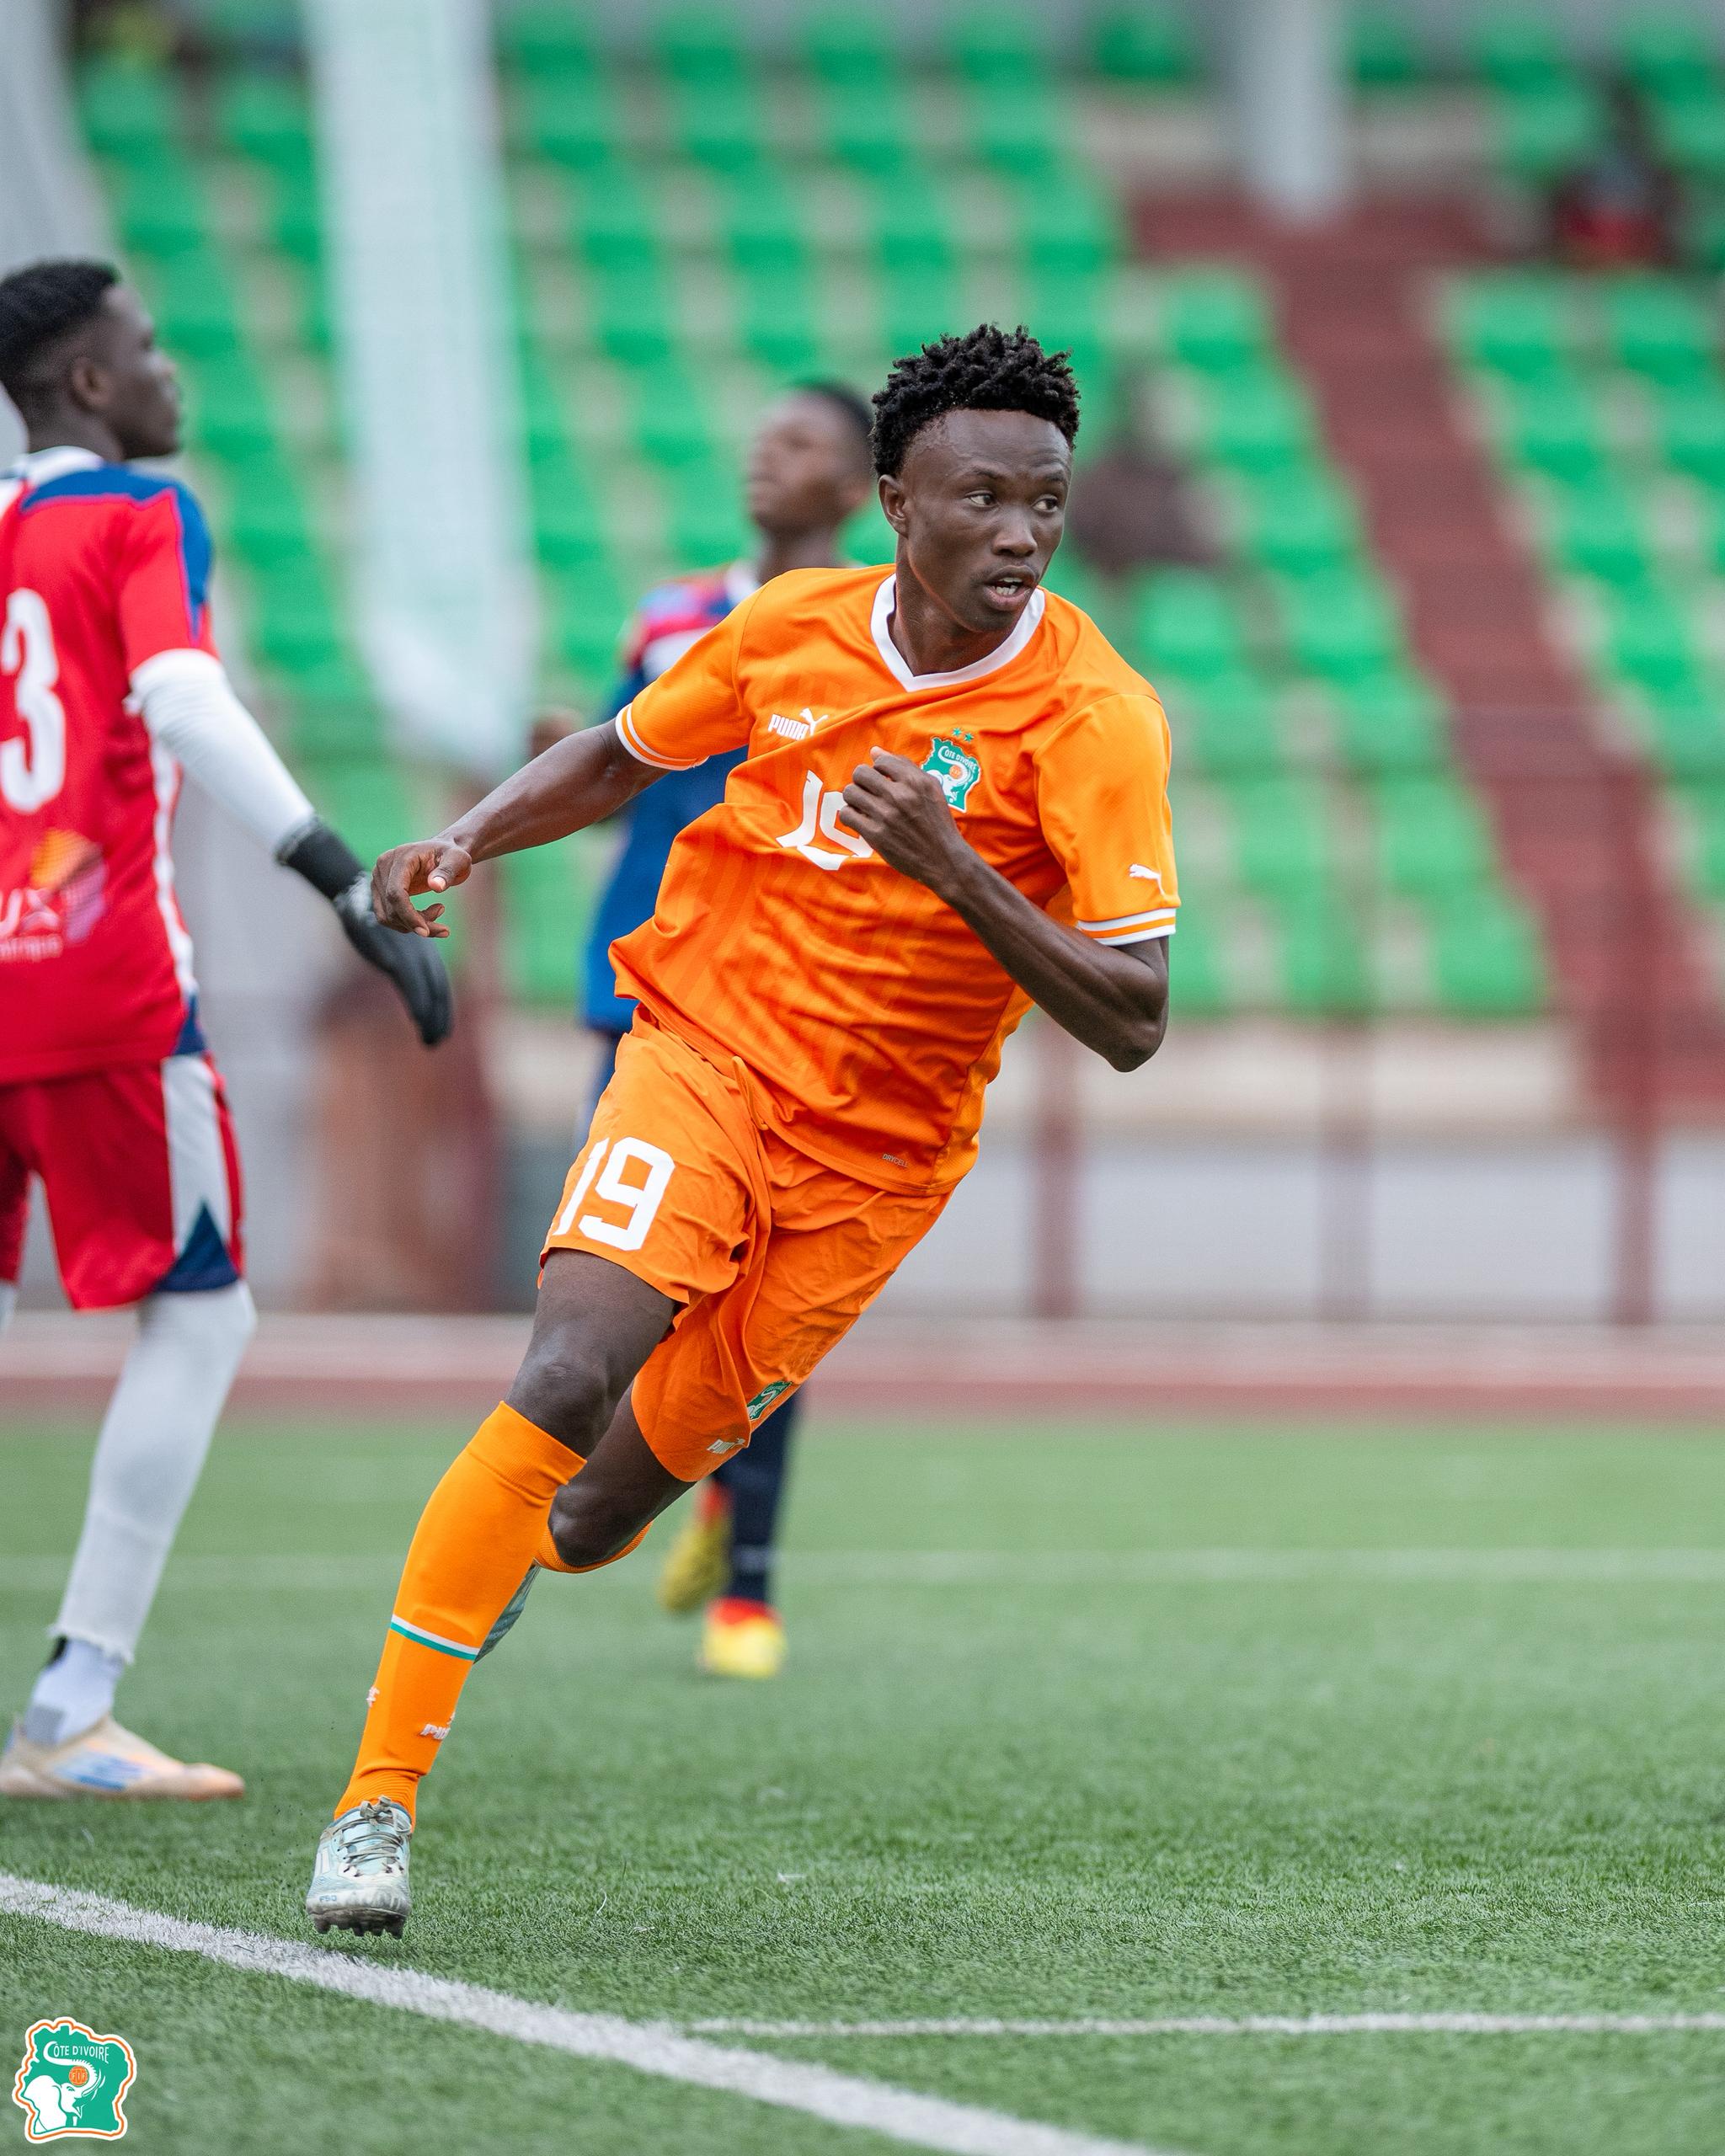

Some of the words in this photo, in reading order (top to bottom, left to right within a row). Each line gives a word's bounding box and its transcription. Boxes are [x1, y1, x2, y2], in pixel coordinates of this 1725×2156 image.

[0, 587, 66, 814] 3
[767, 714, 809, 740] PUMA
[553, 1137, 676, 1251] 19
